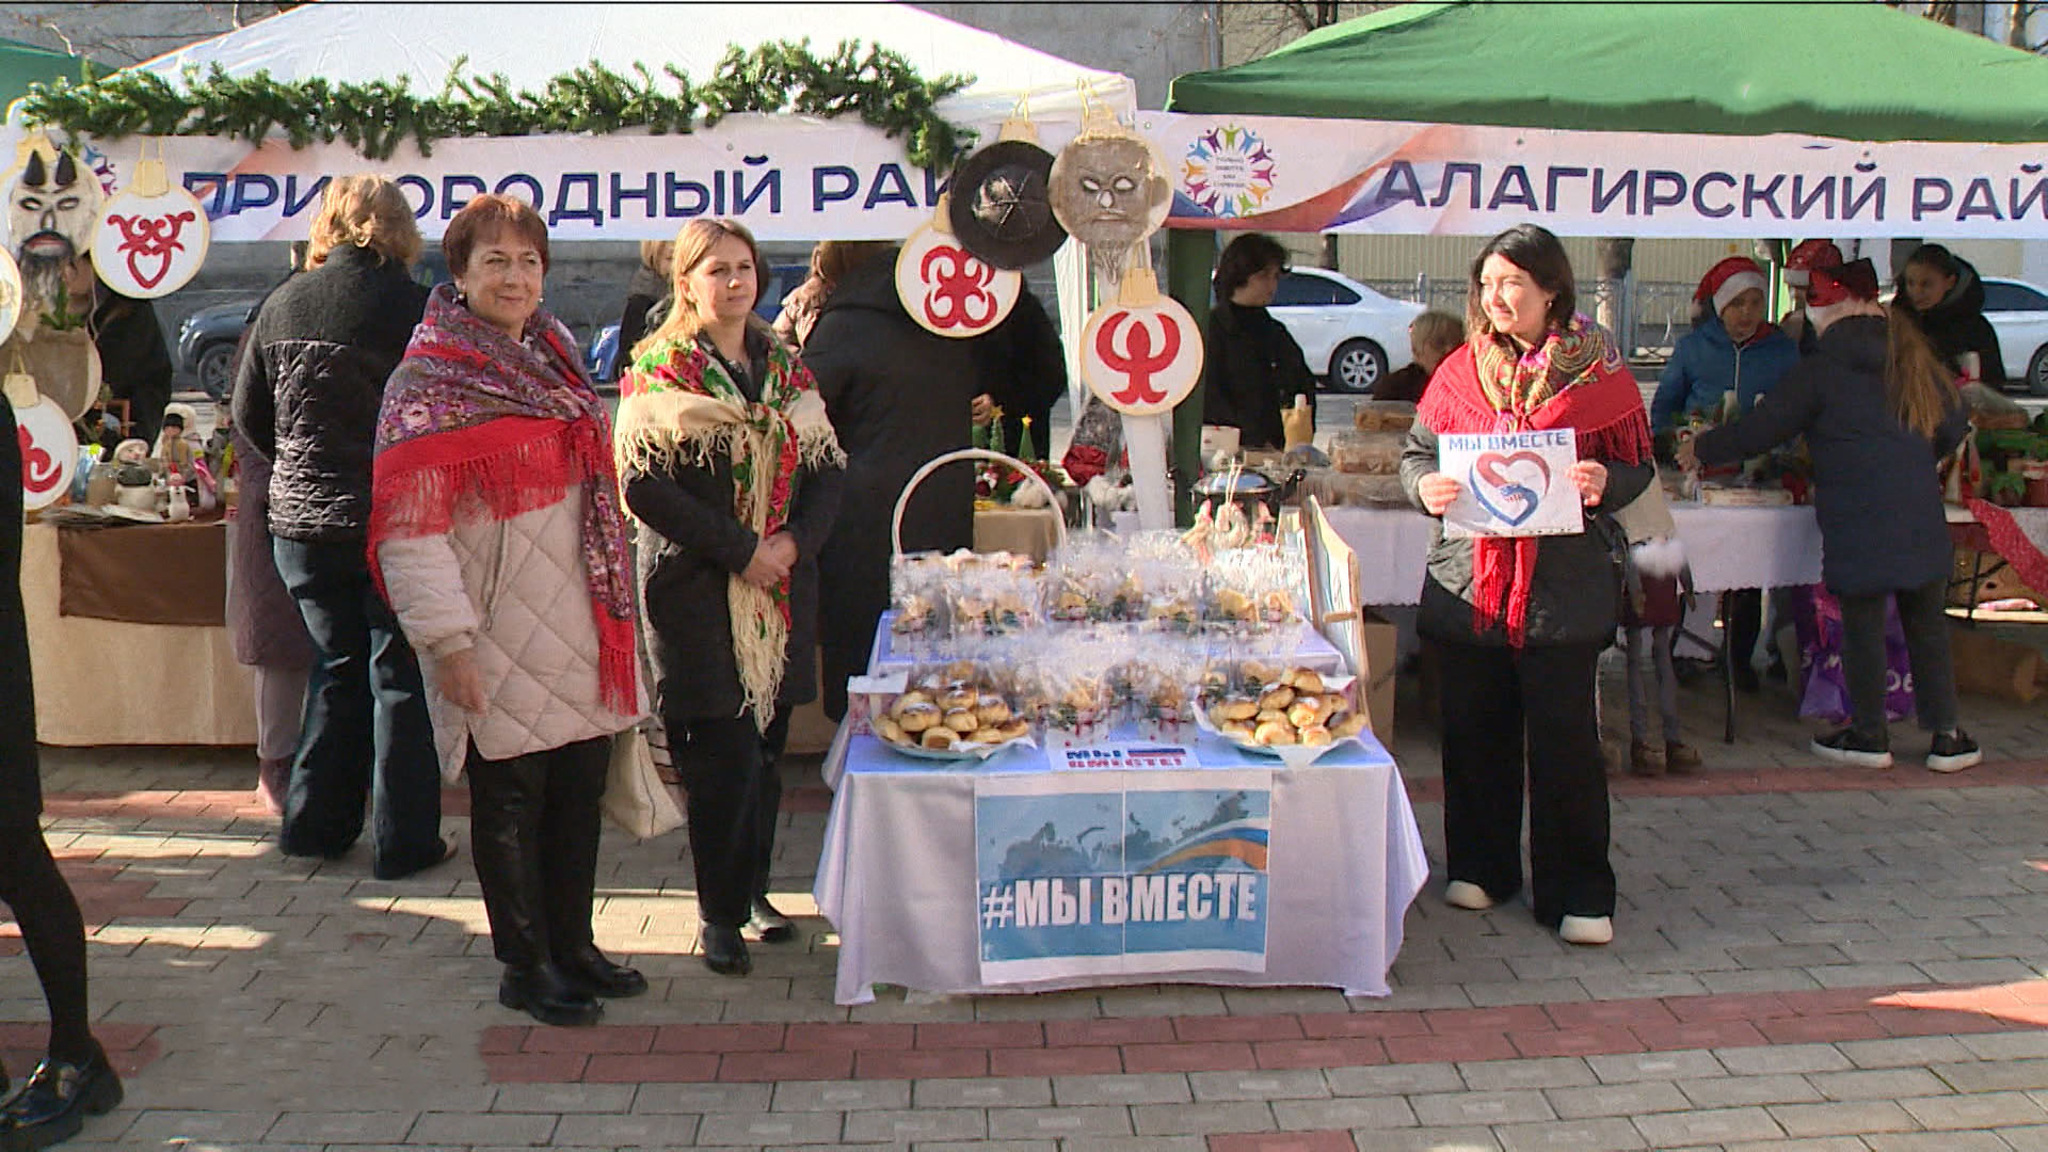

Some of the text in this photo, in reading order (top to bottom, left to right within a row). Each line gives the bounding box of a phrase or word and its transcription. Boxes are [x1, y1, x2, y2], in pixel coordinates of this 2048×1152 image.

[183, 155, 781, 226] ПРИОРОДНЫЙ
[1376, 160, 1886, 221] АЛАГИРСКИЙ
[1449, 432, 1568, 450] МЫ ВМЕСТЕ
[982, 873, 1257, 929] #МЫ ВМЕСТЕ
